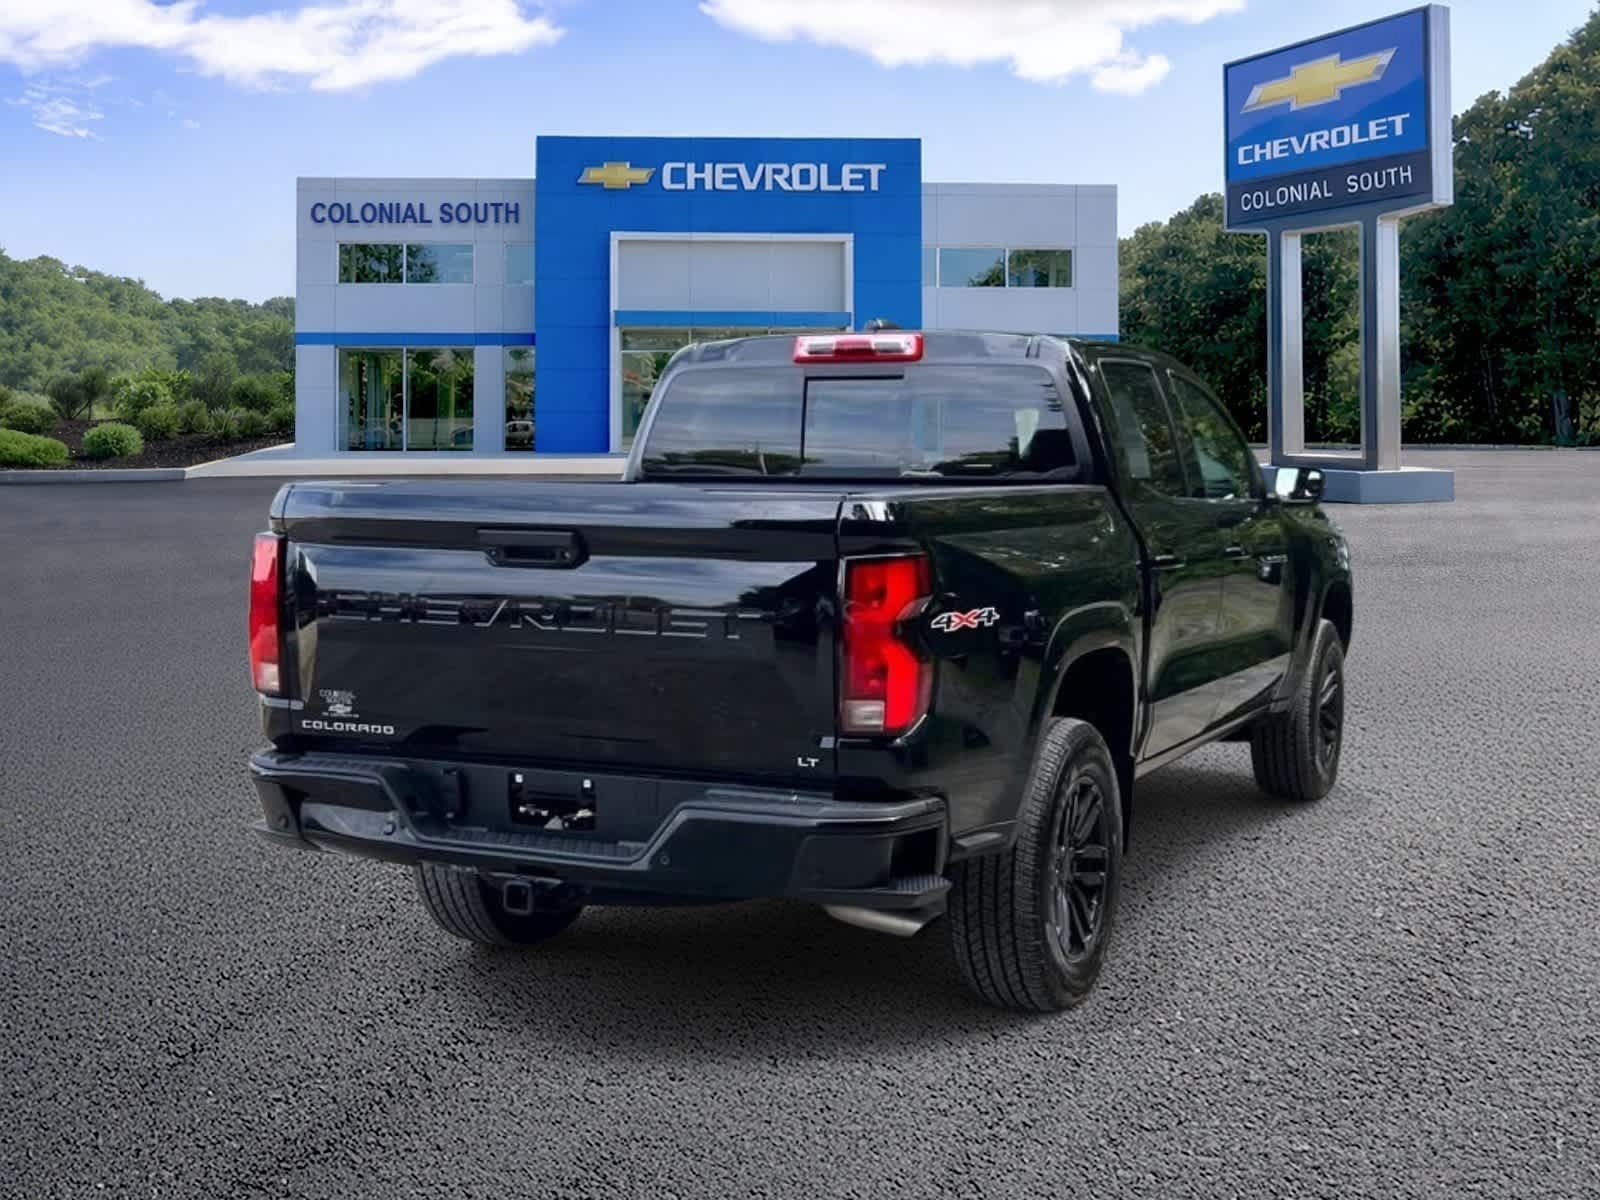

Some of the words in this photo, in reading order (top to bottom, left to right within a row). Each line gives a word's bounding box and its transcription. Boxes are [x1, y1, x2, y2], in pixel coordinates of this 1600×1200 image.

[1237, 113, 1410, 165] CHEVROLET
[662, 162, 887, 192] CHEVROLET
[1240, 180, 1333, 212] COLONIAL
[1346, 165, 1412, 194] SOUTH
[310, 202, 432, 225] COLONIAL
[438, 202, 520, 225] SOUTH
[301, 719, 395, 735] COLORADO
[797, 757, 820, 768] LT
